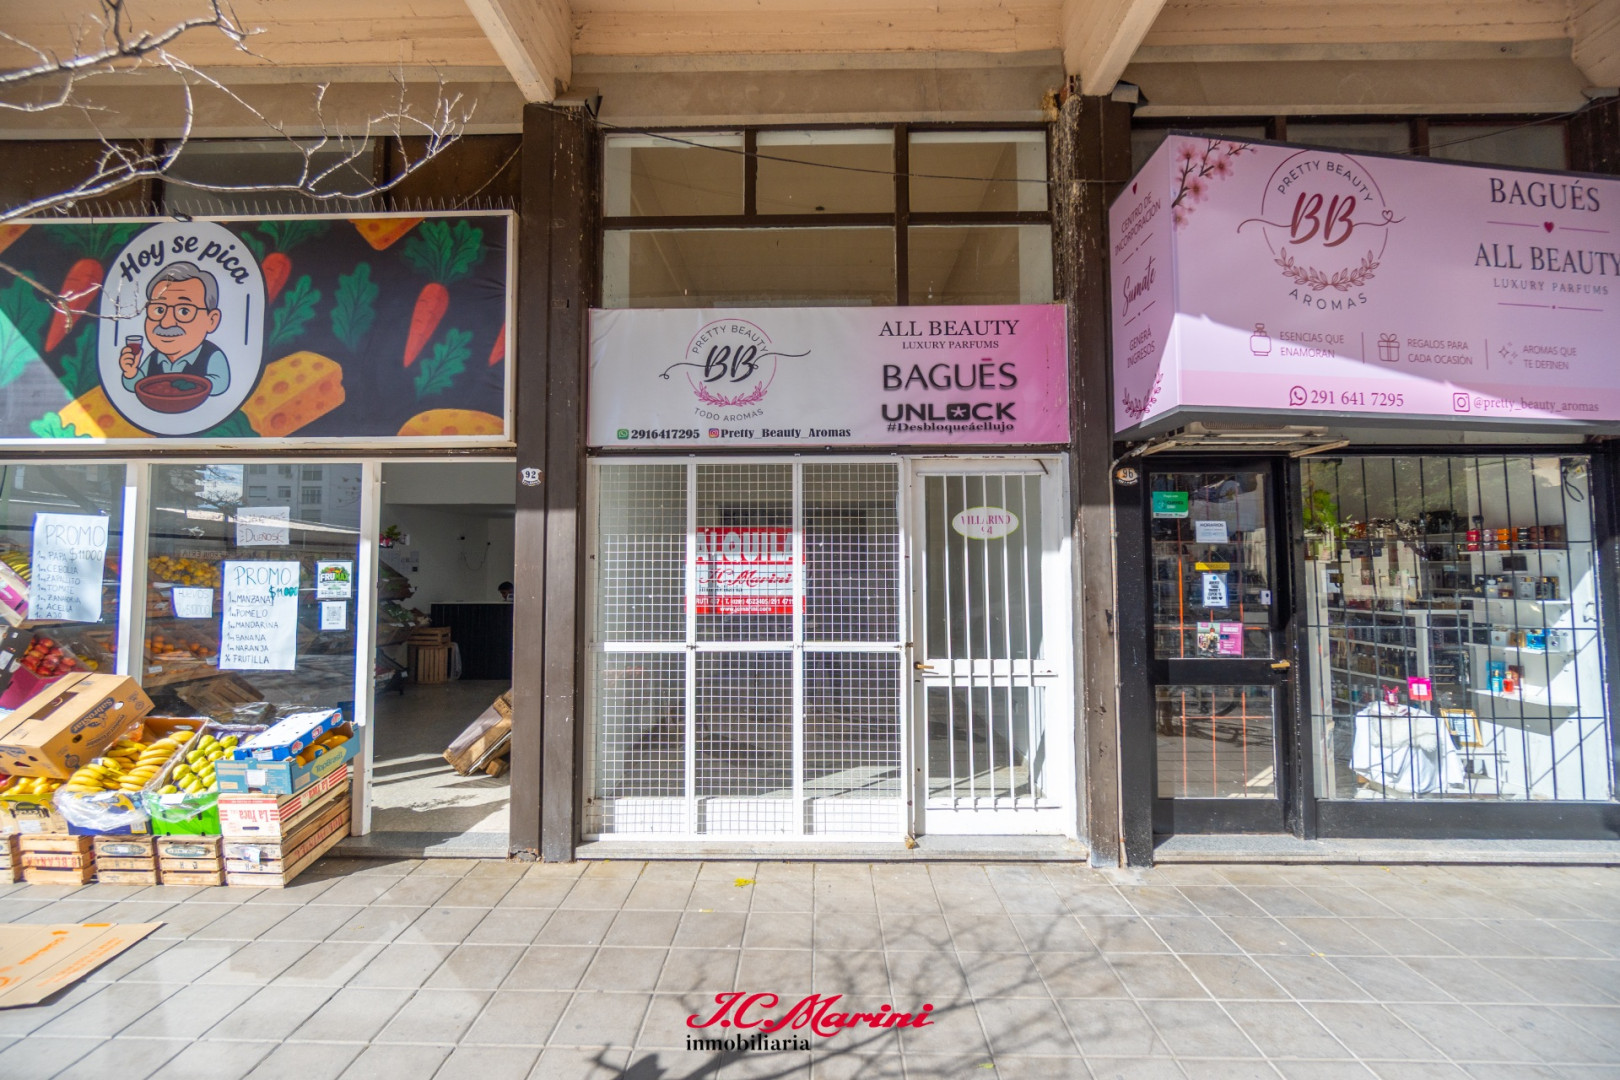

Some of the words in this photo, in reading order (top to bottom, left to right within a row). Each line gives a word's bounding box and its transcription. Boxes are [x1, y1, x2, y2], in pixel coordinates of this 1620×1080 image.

[1277, 160, 1320, 194] PRETTY
[1327, 161, 1373, 202] BEAUTY
[1490, 178, 1601, 212] BAGUÉS
[1121, 203, 1143, 233] CENTRO
[1144, 191, 1152, 208] DE
[1289, 192, 1356, 248] BB
[120, 240, 164, 282] Hoy
[172, 235, 198, 253] se
[198, 241, 249, 285] pica
[1474, 243, 1522, 270] ALL
[1529, 246, 1620, 277] BEAUTY
[1493, 278, 1545, 291] LUXURY
[1552, 282, 1609, 296] PARFUMS
[1289, 288, 1368, 311] AROMAS
[878, 321, 922, 337] ALL
[928, 320, 1020, 336] BEAUTY
[692, 325, 727, 354] PRETTY
[731, 325, 769, 353] BEAUTY
[902, 341, 947, 350] LUXURY
[949, 340, 999, 349] PARFUMS
[1129, 327, 1152, 351] GENERA
[1280, 331, 1323, 343] ESENCIAS
[1325, 334, 1344, 345] QUE
[1407, 339, 1445, 350] REGALOS
[1447, 340, 1469, 350] PARA
[1127, 340, 1155, 368] INGRESOS
[1280, 347, 1335, 358] ENAMORAN
[1408, 353, 1432, 364] CADA
[1434, 354, 1473, 365] OCASIÓN
[1523, 345, 1558, 356] AROMAS
[1560, 347, 1577, 357] QUE
[703, 344, 757, 383] BB
[1523, 359, 1533, 369] TE
[1535, 359, 1569, 370] DEFINEN
[1311, 390, 1335, 404] 291
[1341, 391, 1365, 406] 641
[1371, 392, 1404, 407] 7295
[1473, 397, 1599, 414] @pretty_beauty_aromas
[694, 407, 720, 421] TODO
[723, 408, 764, 422] AROMAS
[631, 428, 700, 440] 2916417295
[720, 428, 851, 441] Pretty_Beauty_Aromas
[525, 470, 536, 479] 92
[1122, 468, 1134, 479] 96
[46, 524, 106, 547] PROMO
[234, 565, 292, 586] PROMO
[233, 654, 270, 664] FRUTILLA
